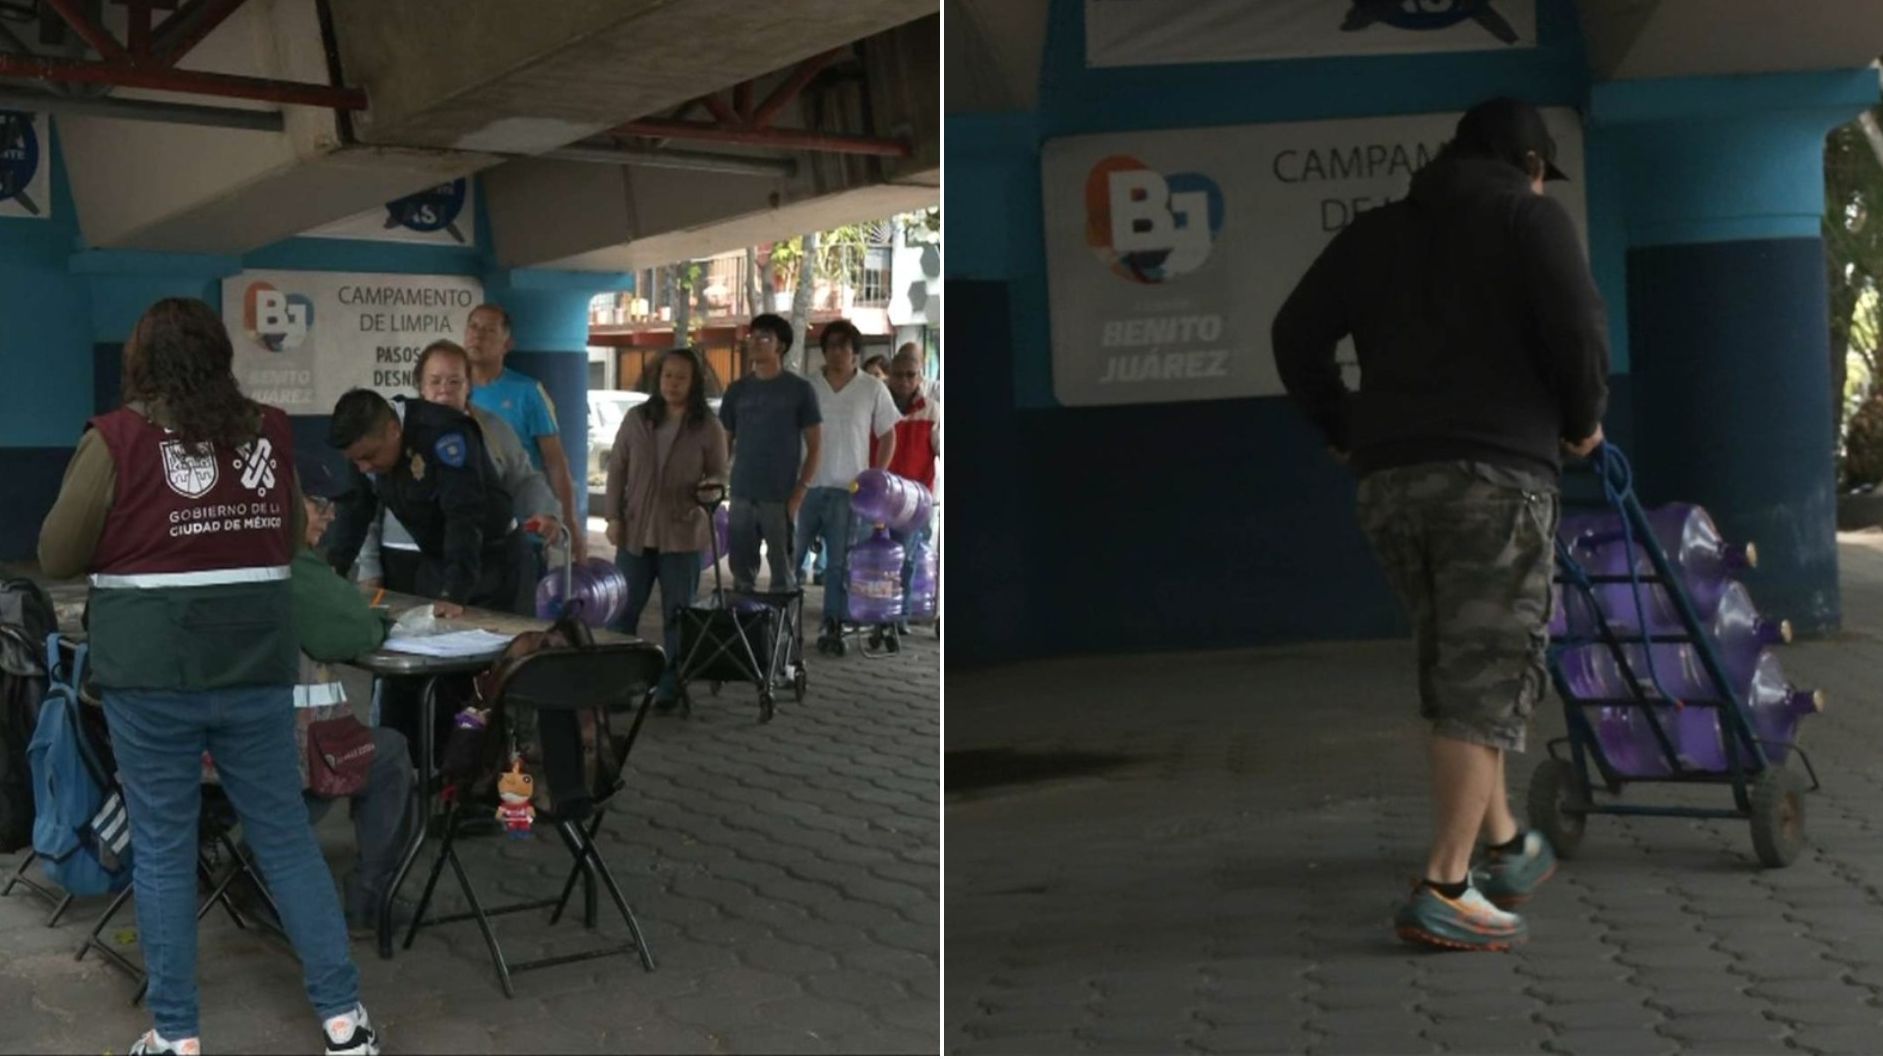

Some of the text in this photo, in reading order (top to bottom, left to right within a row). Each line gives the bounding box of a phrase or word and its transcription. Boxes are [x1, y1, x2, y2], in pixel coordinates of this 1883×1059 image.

[338, 286, 473, 308] CAMPAMENTO
[360, 313, 453, 333] DE LIMPIA
[1101, 314, 1223, 347] BENITO
[376, 346, 421, 363] PASOS
[1099, 346, 1229, 384] JUÁREZ
[169, 503, 247, 523] GOBIERNO
[251, 503, 266, 514] DE
[169, 520, 221, 536] CIUDAD
[224, 518, 241, 531] DE
